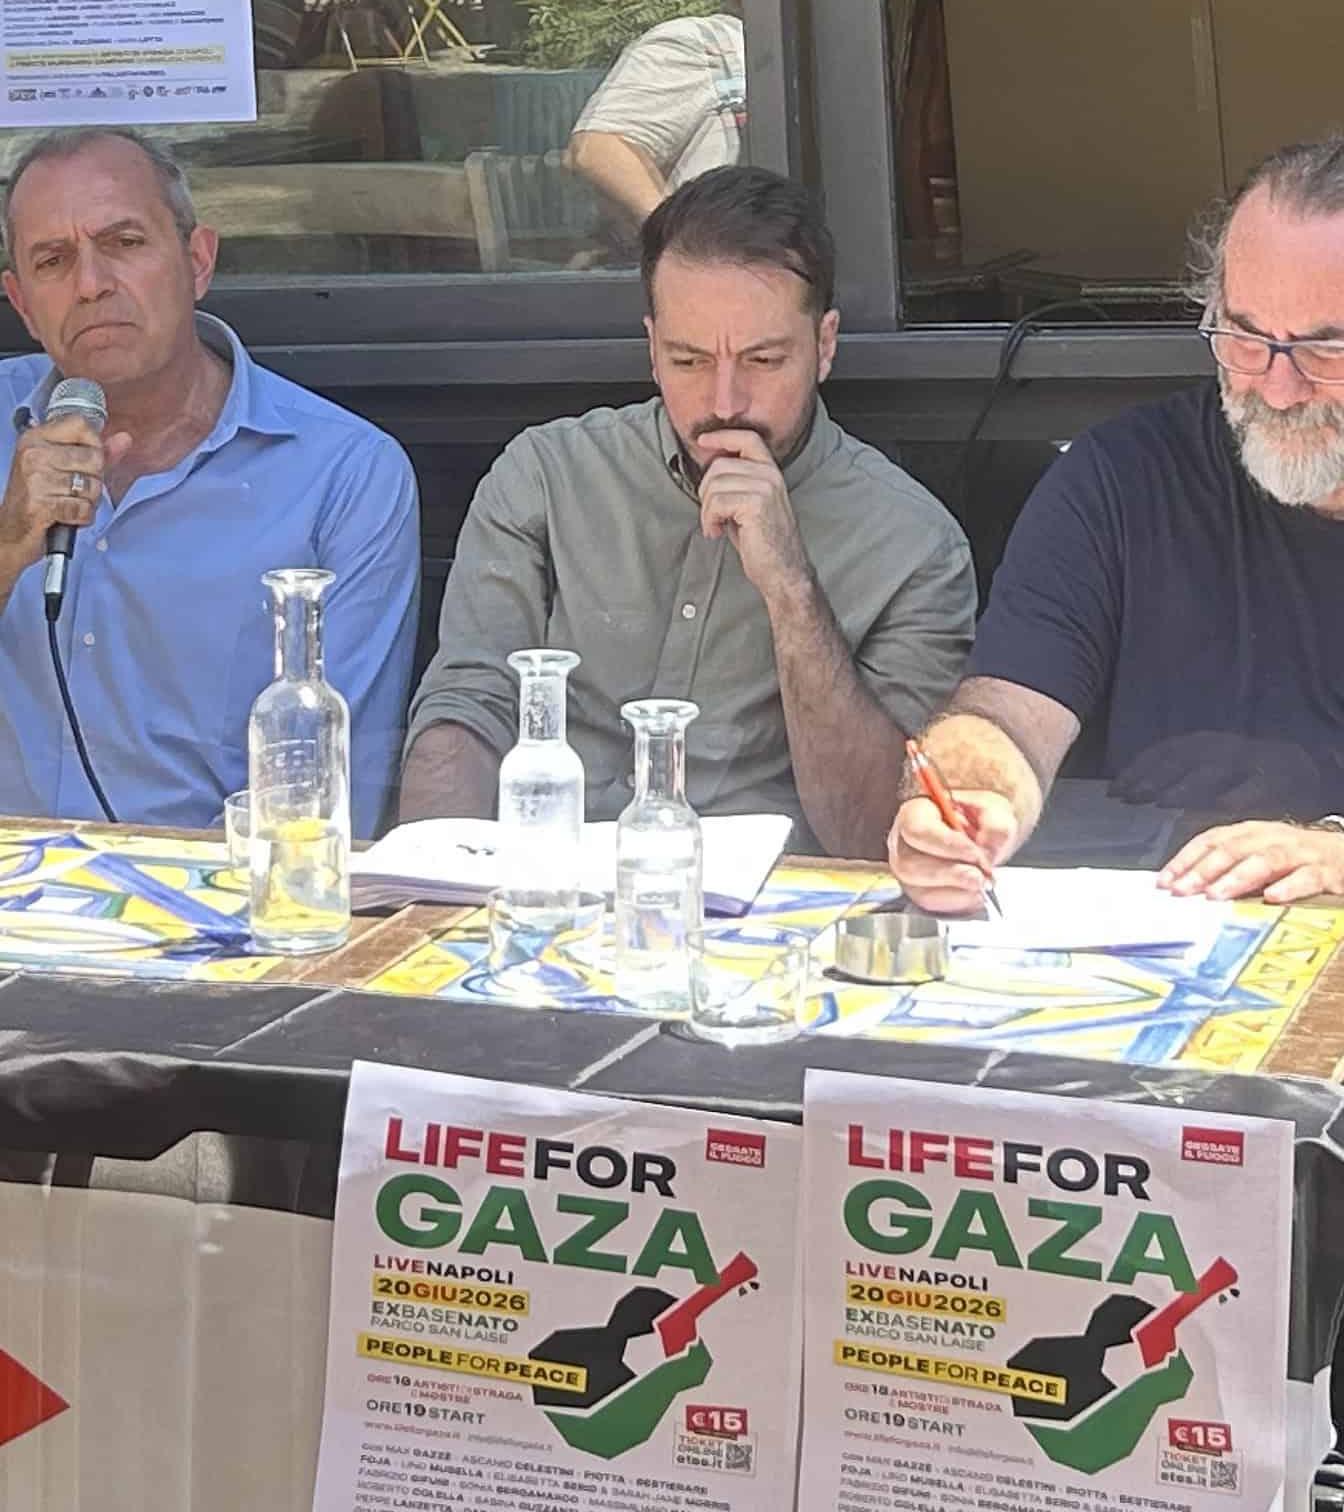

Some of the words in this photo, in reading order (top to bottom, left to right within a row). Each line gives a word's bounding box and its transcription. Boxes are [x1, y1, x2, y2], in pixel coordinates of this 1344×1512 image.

[385, 1117, 676, 1199] LIFEFOR
[847, 1124, 1151, 1201] LIFEFOR
[376, 1173, 720, 1285] GAZA
[842, 1178, 1200, 1293] GAZA
[378, 1278, 525, 1310] 20GIU2026
[850, 1284, 1002, 1317] 20GIU2026
[370, 1316, 424, 1333] PARCO
[429, 1325, 461, 1339] SAN
[846, 1323, 901, 1339] PARCO
[904, 1330, 937, 1345] SAN
[367, 1339, 452, 1366] PEOPLE
[457, 1353, 500, 1373] FOR
[504, 1361, 579, 1386] PEACE
[842, 1346, 930, 1373] PEOPLE
[934, 1361, 979, 1382] FOR
[983, 1369, 1058, 1397] PEACE
[692, 1410, 742, 1430] €15
[1175, 1426, 1227, 1446] €15
